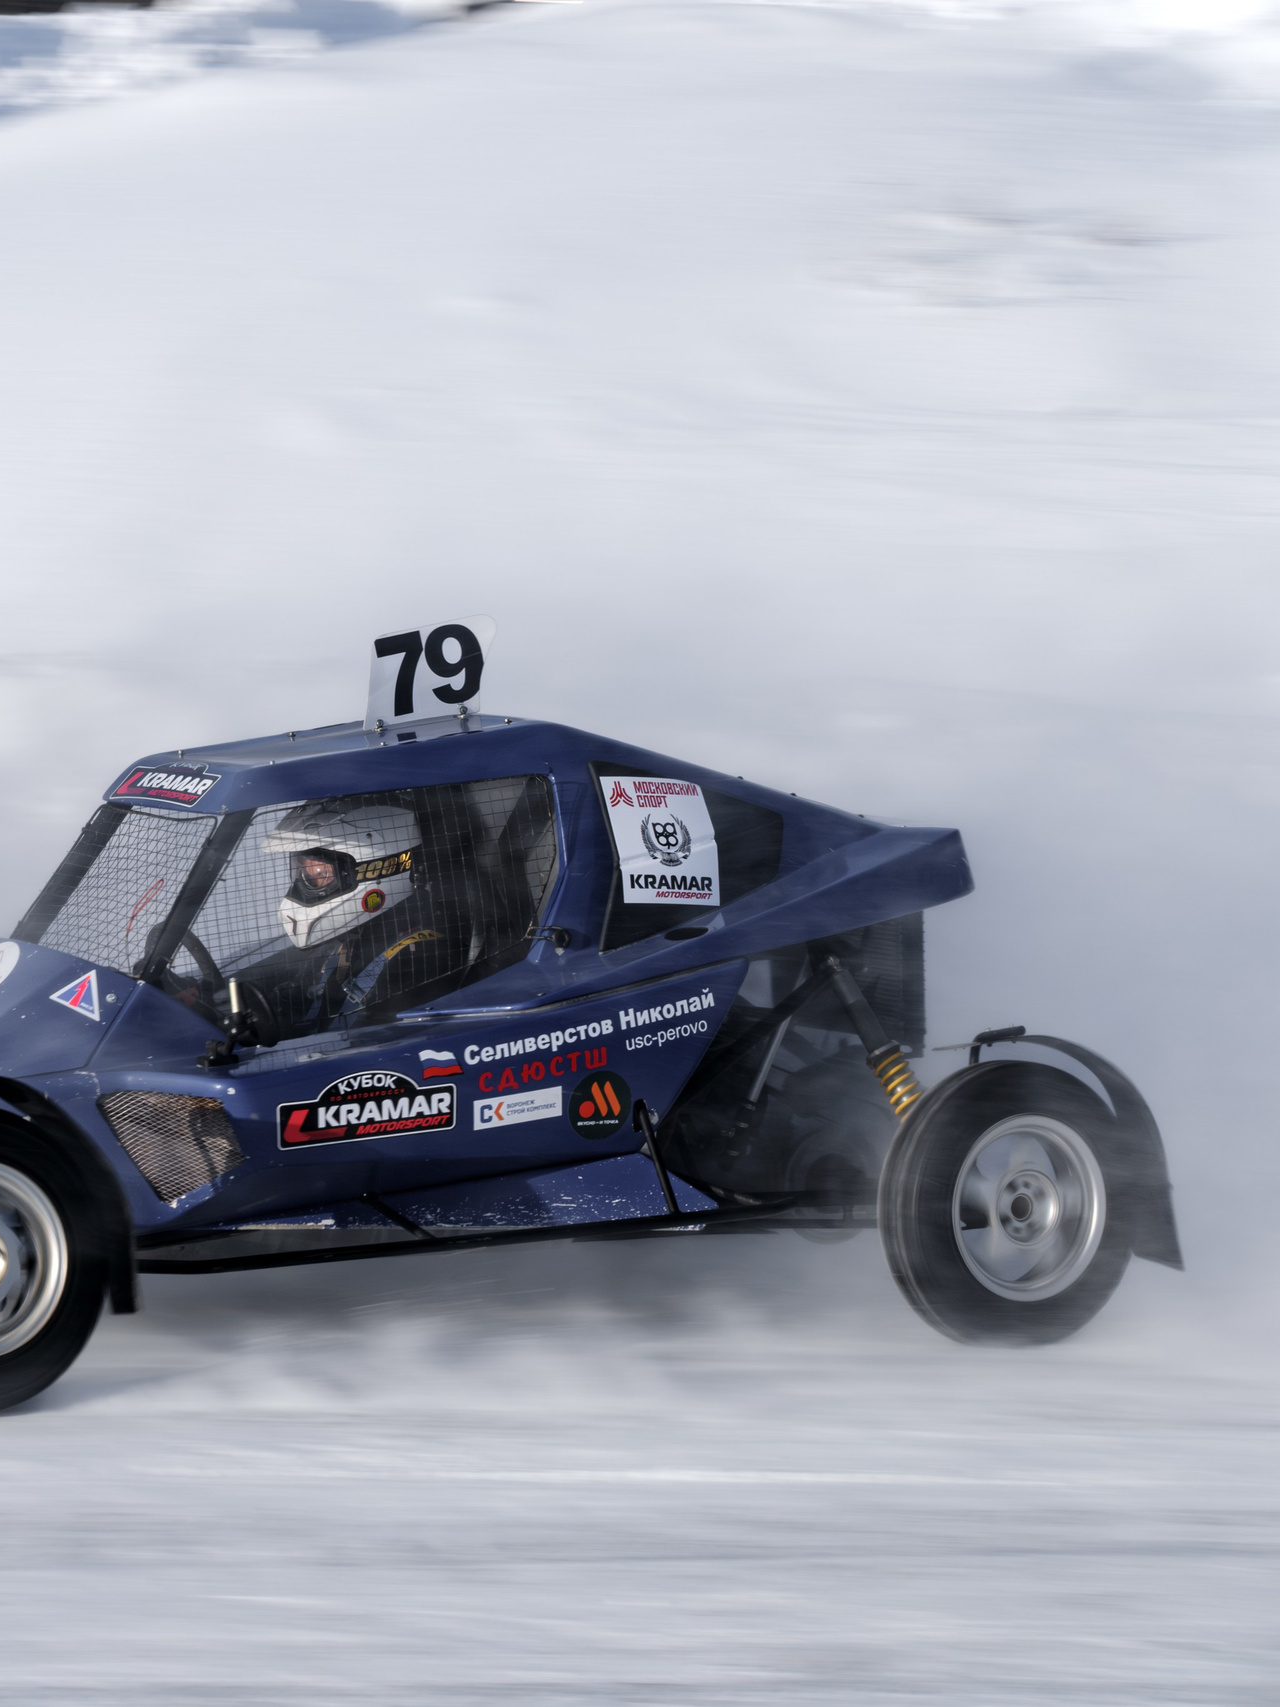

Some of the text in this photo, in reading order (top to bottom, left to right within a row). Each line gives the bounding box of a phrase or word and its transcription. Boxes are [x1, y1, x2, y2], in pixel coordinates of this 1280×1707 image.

[374, 624, 485, 717] 79
[136, 772, 213, 795] KRAMAR
[636, 795, 668, 808] СПОРТ
[355, 851, 412, 881] 100%
[629, 873, 713, 892] KRAMAR
[655, 890, 713, 900] MOTORSPORT
[464, 988, 715, 1065] Селиверстов Николай
[624, 1019, 709, 1051] usc-perovo
[479, 1047, 607, 1092] СДЮСТШ
[337, 1074, 398, 1095] КУБОК
[317, 1092, 451, 1129] KRAMAR
[506, 1099, 535, 1110] ВОРОНЕЖ
[506, 1106, 526, 1117] СТРОЙ
[355, 1114, 451, 1136] MOTORSPORT
